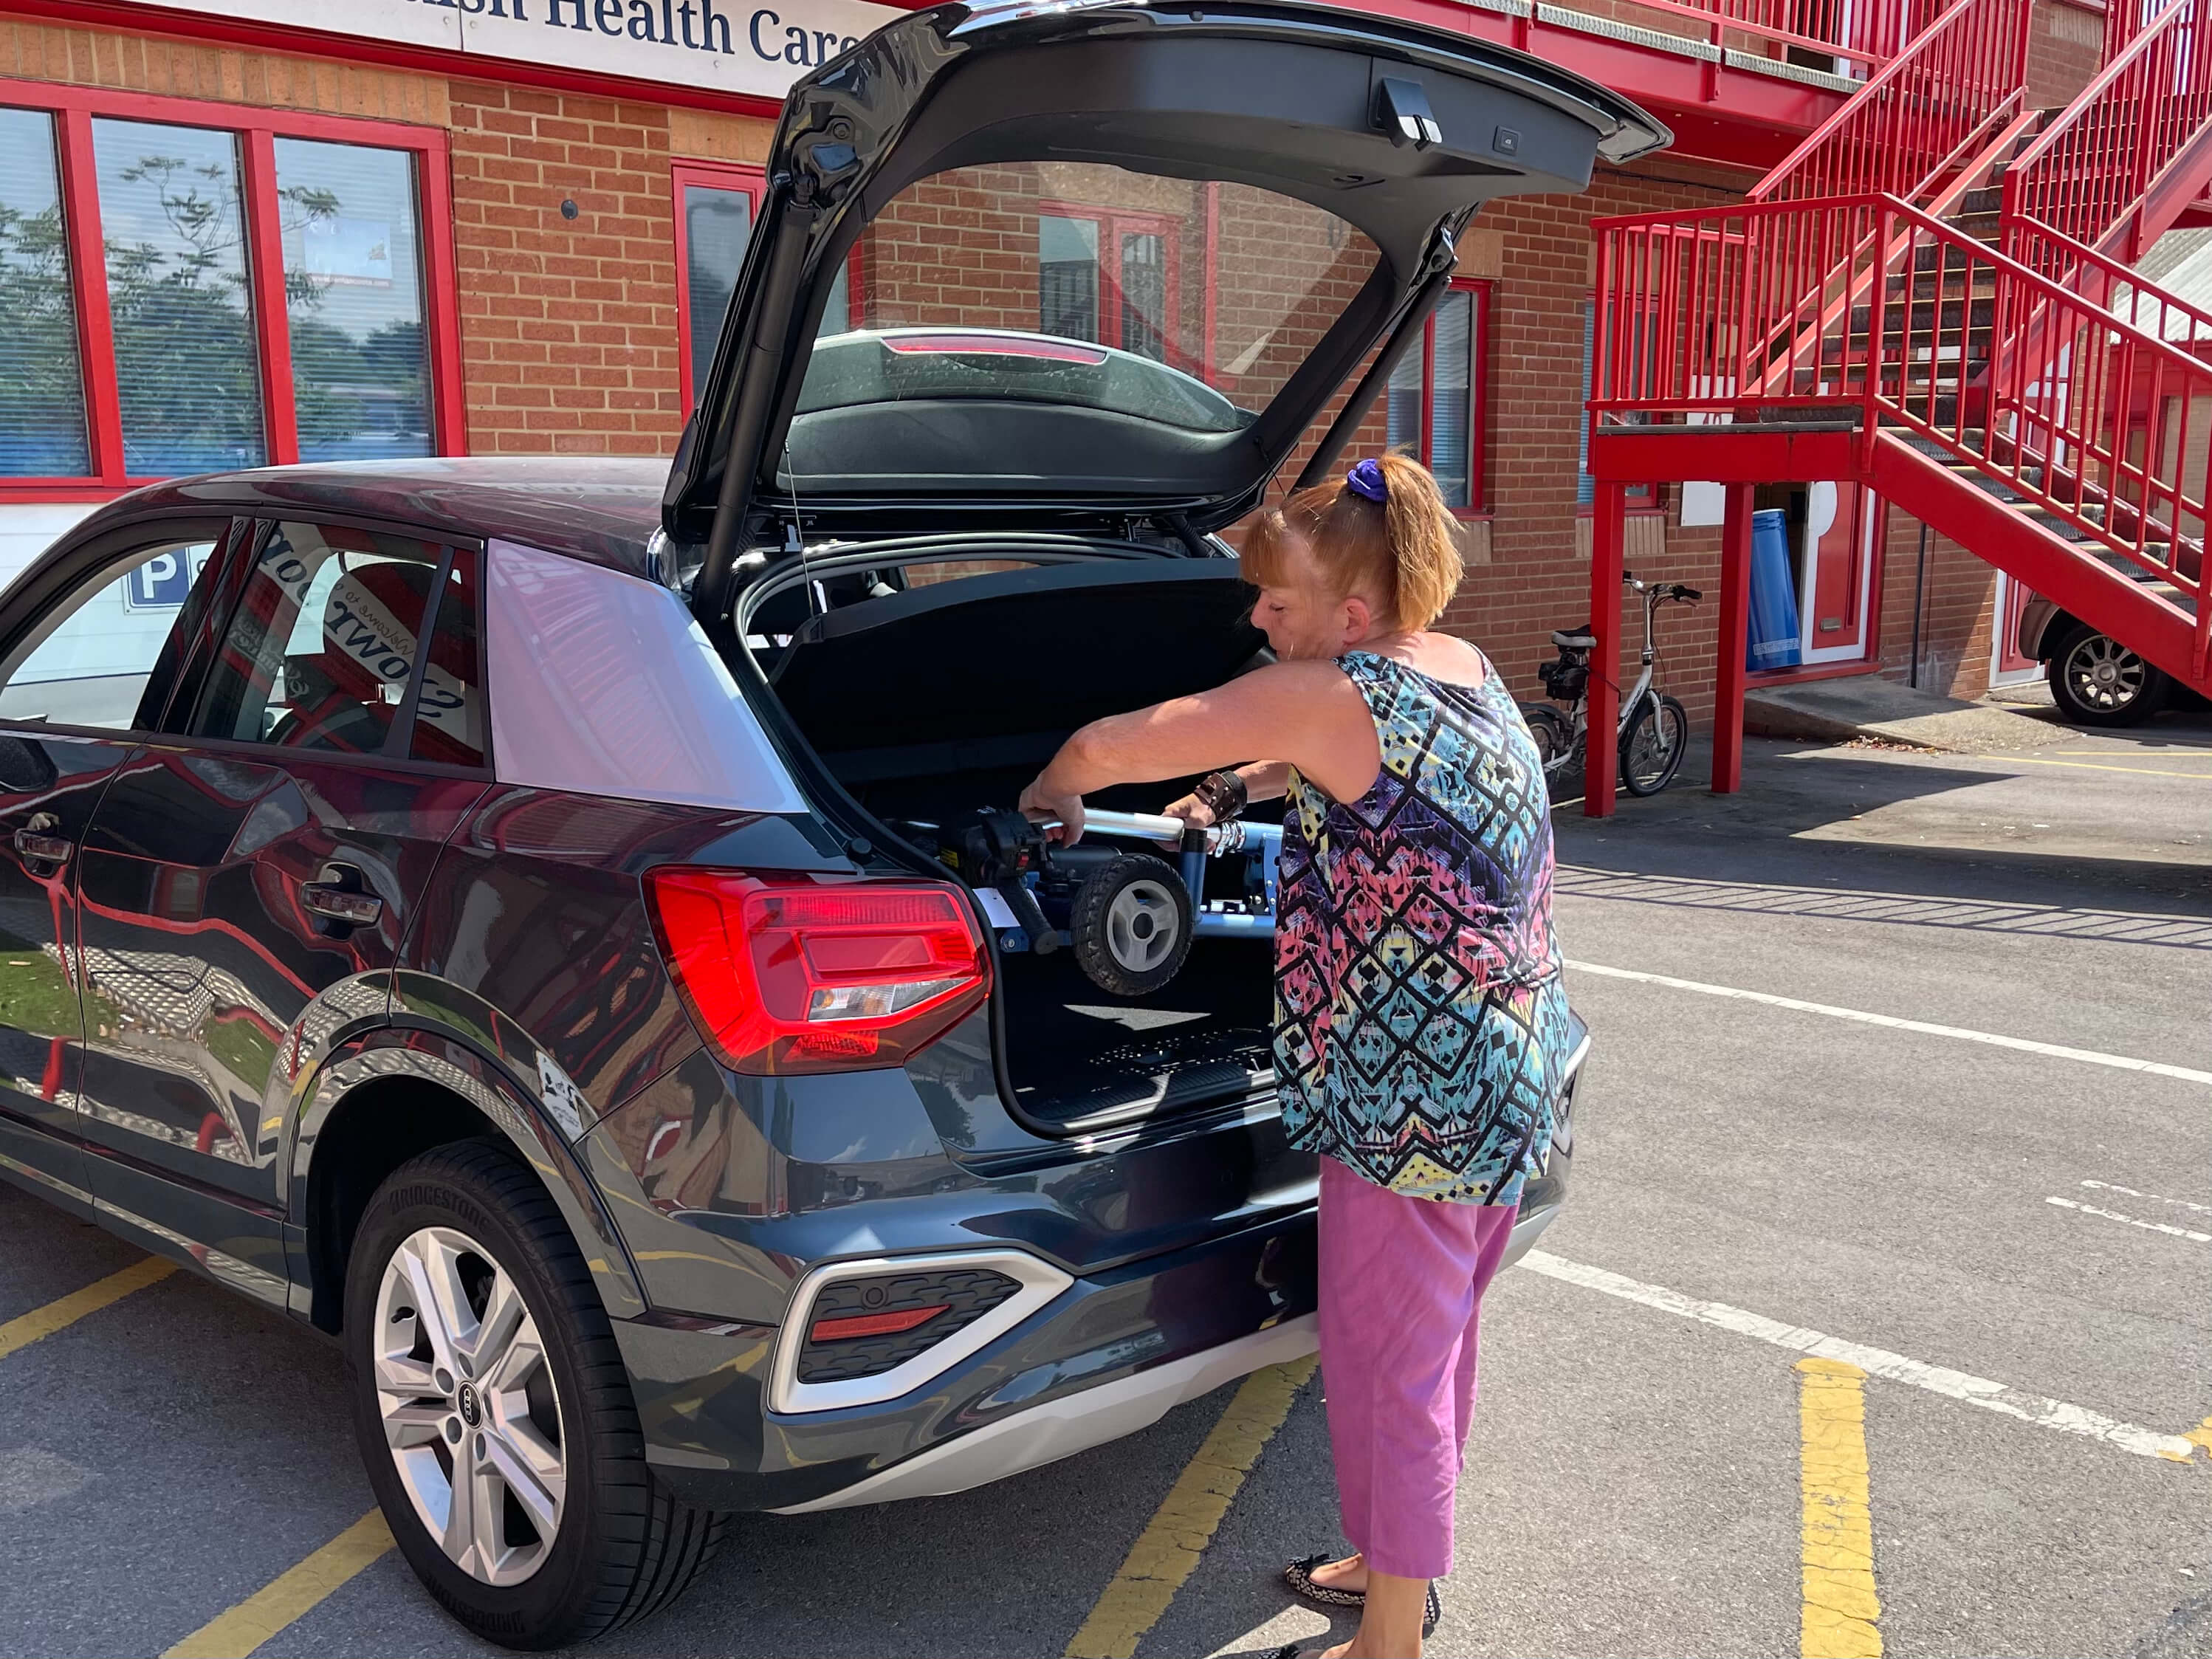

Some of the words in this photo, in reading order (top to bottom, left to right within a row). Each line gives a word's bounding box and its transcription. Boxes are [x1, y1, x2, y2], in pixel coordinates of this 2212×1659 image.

[545, 0, 735, 55] Health
[141, 552, 177, 600] P
[390, 1186, 491, 1235] BRIDGESTONE
